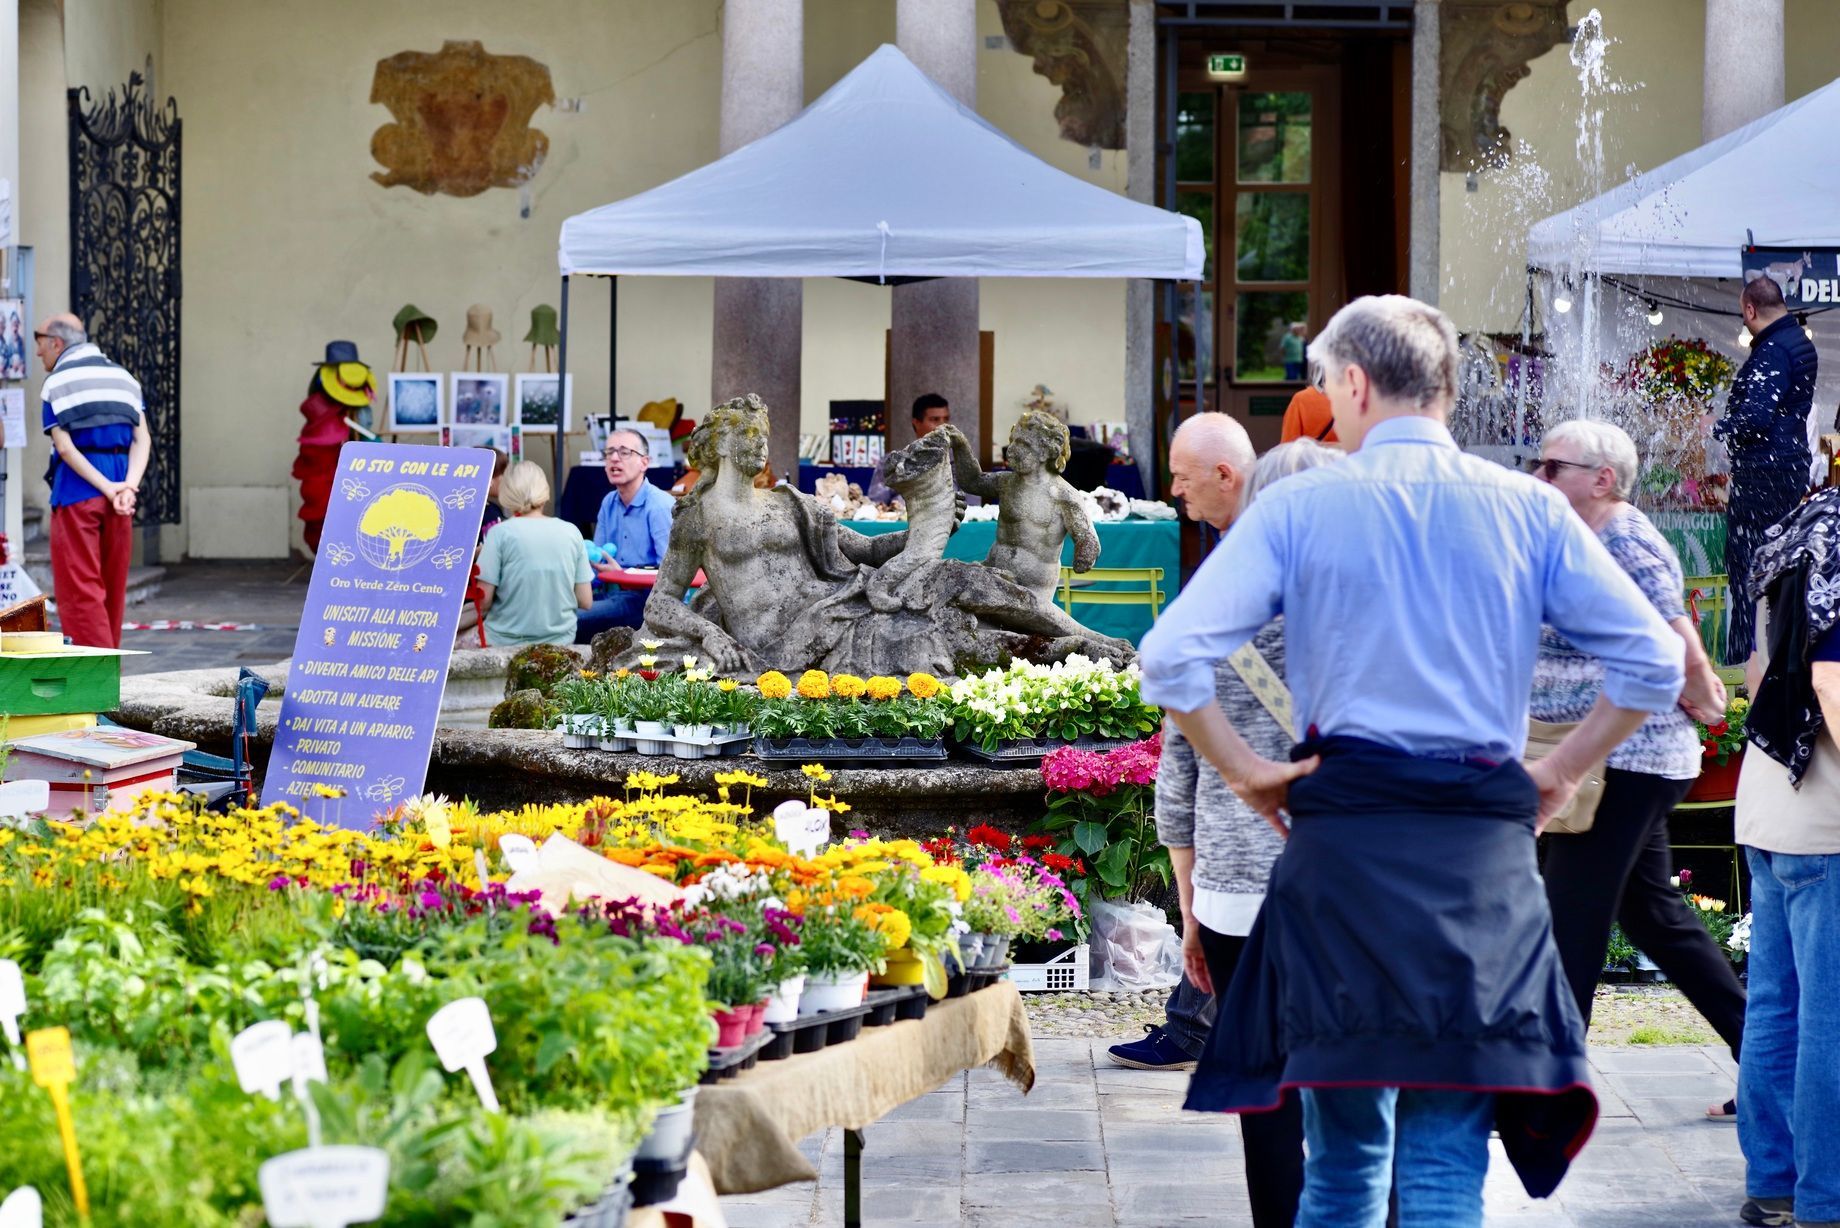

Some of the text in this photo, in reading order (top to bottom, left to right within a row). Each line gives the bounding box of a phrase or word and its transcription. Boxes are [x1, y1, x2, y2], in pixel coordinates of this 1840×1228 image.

[349, 458, 480, 478] IO STO CON LE API
[330, 577, 351, 588] Oro
[354, 578, 384, 590] Verde
[412, 583, 443, 594] Cento
[323, 604, 440, 628] UNISCITI ALLA NOSTRA
[347, 630, 402, 649] MISSIONE
[304, 661, 439, 684] DIVENTA AMICO DELLE API
[297, 689, 403, 711] ADOTTA UN ALVEARE
[292, 717, 416, 740] DAI VITA A UN APIARIO:
[295, 738, 341, 755] PRIVATO
[291, 759, 366, 779] COMUNITARIO
